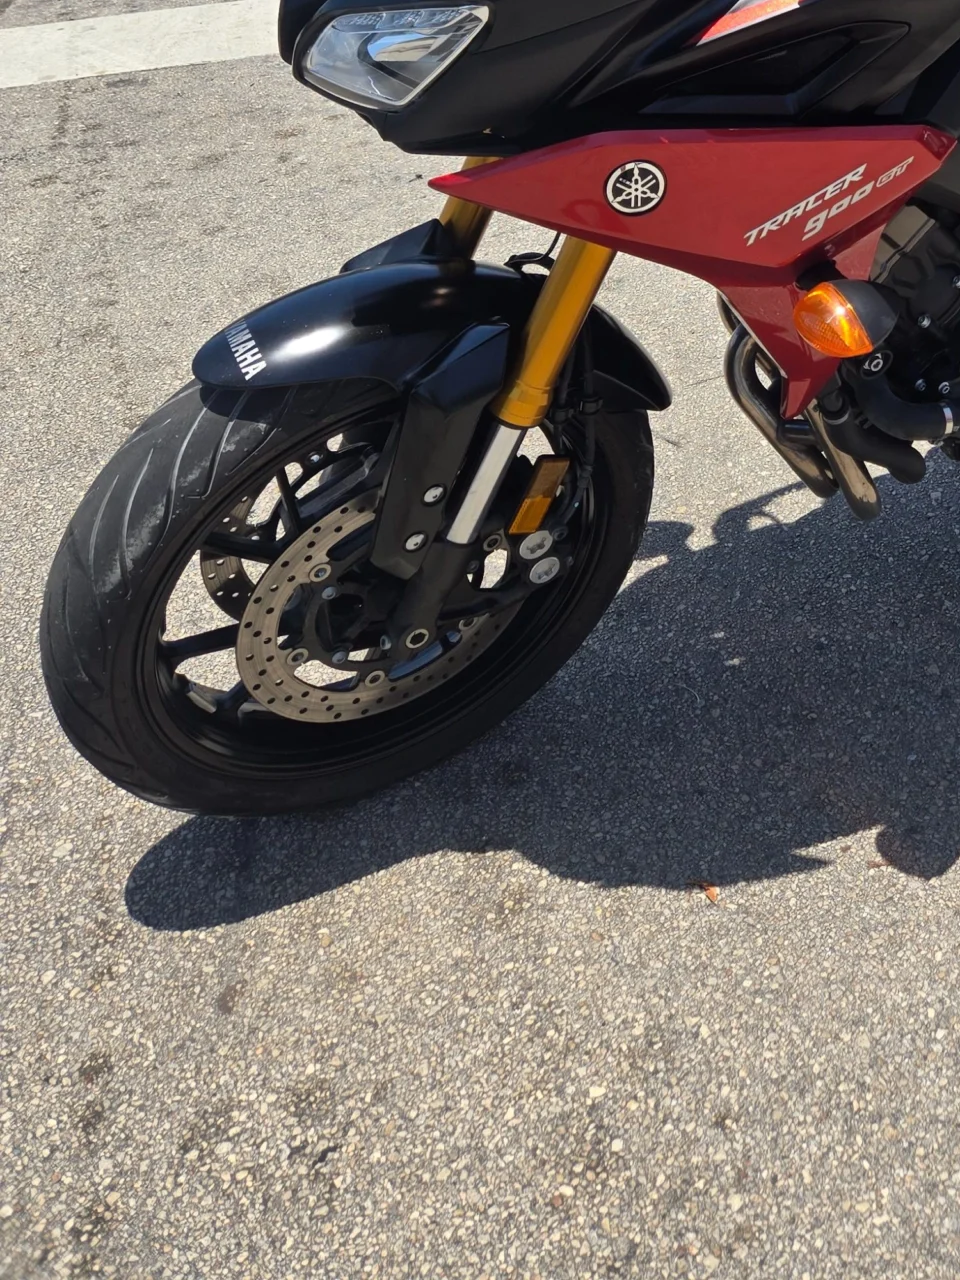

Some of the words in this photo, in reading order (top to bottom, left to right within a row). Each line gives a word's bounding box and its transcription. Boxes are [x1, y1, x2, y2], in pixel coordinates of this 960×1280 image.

[743, 163, 867, 246] TRACER
[801, 181, 875, 241] 900
[876, 156, 914, 187] GT
[224, 320, 267, 380] YAMAHA
